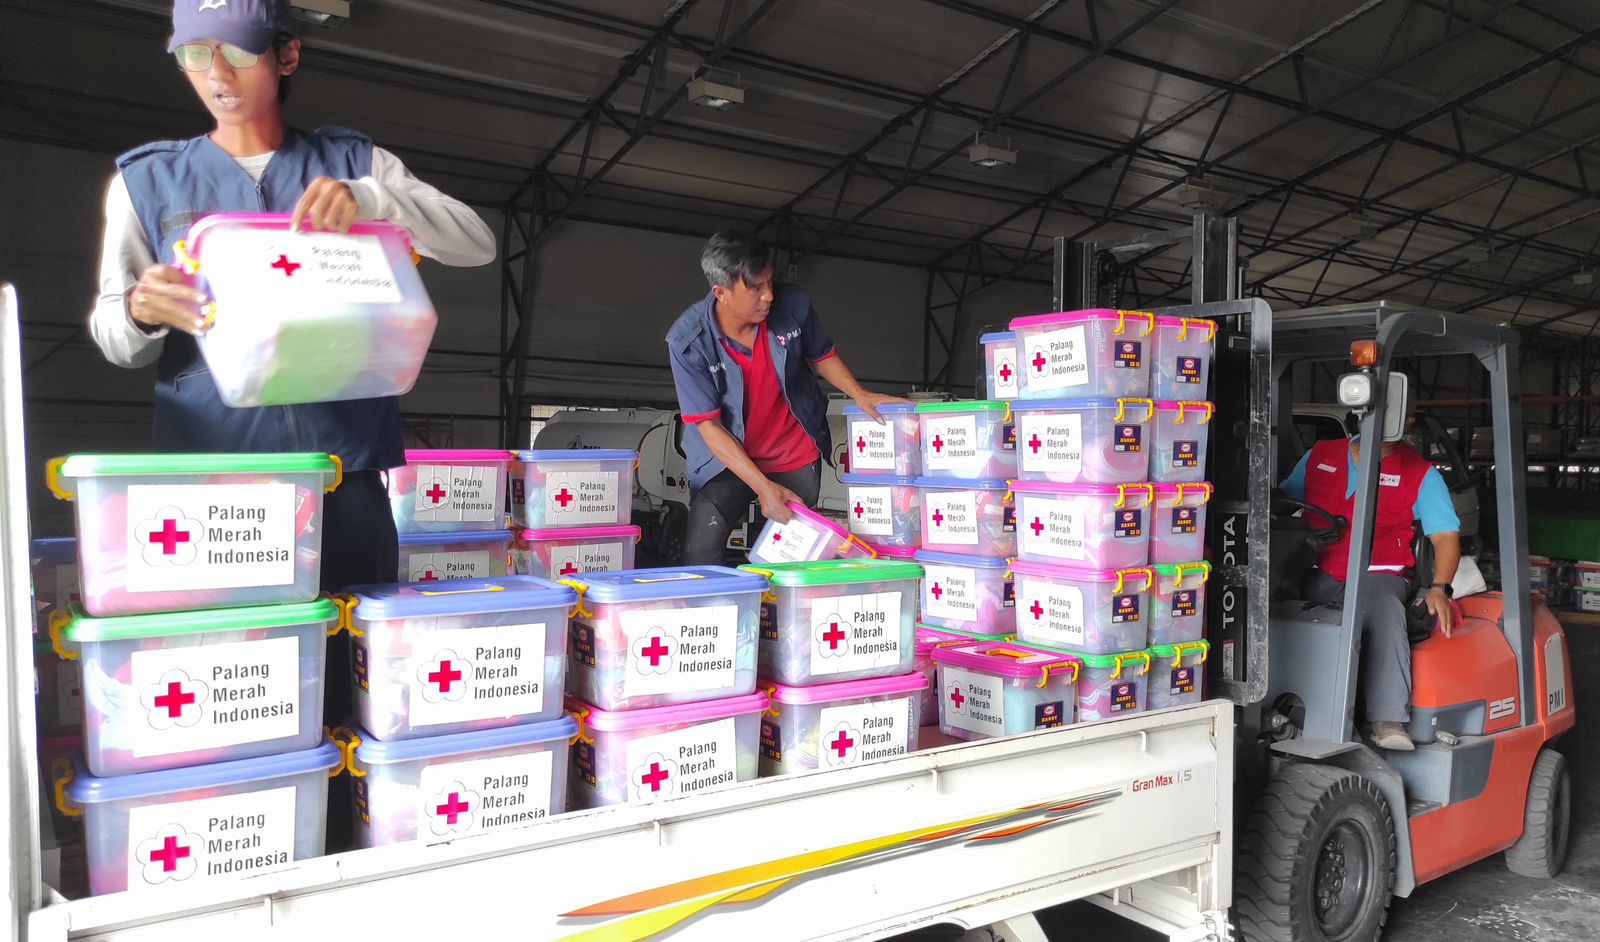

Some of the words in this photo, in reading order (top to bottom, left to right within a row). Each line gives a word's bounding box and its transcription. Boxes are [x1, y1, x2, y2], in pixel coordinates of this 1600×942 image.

[1050, 341, 1073, 351] Palang
[1052, 353, 1072, 363] Merah
[1052, 364, 1085, 376] Indonesia
[869, 430, 885, 439] Palang
[948, 428, 966, 436] Palang
[1047, 427, 1069, 436] Palang
[948, 438, 965, 446] Merah
[1047, 439, 1068, 448] Merah
[1047, 451, 1080, 460] Indonesia
[454, 478, 482, 488] Palang
[580, 482, 606, 491] Palang
[454, 489, 480, 498] Merah
[580, 492, 604, 501] Merah
[453, 500, 492, 510] Indonesia
[579, 503, 615, 512] Indonesia
[948, 503, 966, 511] Palang
[208, 505, 266, 522] Palang
[1050, 511, 1072, 523] Palang
[208, 527, 262, 542] Merah
[1050, 524, 1070, 534] Merah
[1050, 536, 1082, 547] Indonesia
[208, 547, 289, 564] Indonesia
[447, 563, 474, 571] Palang
[1223, 516, 1235, 629] TOOTA
[946, 576, 965, 588] Palang
[1049, 596, 1071, 609] Palang
[854, 611, 885, 623] Palang
[1049, 608, 1070, 619] Merah
[680, 625, 718, 638] Palang
[854, 626, 883, 638] Merah
[1049, 621, 1081, 634] Indonesia
[476, 646, 521, 660] Palang
[680, 642, 715, 655] Merah
[854, 640, 897, 655] Indonesia
[212, 664, 269, 680] Palang
[476, 664, 518, 680] Merah
[679, 658, 732, 673] Indonesia
[213, 684, 266, 703] Merah
[474, 682, 539, 699] Indonesia
[969, 684, 991, 699] Palang
[970, 697, 990, 710] Merah
[1550, 688, 1563, 709] PMI
[213, 702, 293, 725] Indonesia
[1490, 697, 1515, 720] 25
[863, 716, 893, 729] Palang
[970, 709, 1002, 725] Indonesia
[863, 731, 891, 745] Merah
[680, 741, 716, 758] Palang
[862, 744, 904, 761] Indonesia
[680, 758, 715, 776] Merah
[484, 775, 528, 790] Palang
[680, 770, 733, 793] Indonesia
[1132, 779, 1153, 792] Gran
[1156, 775, 1173, 788] Max
[483, 792, 524, 809] Merah
[208, 814, 265, 832] Palang
[482, 808, 545, 828] Indonesia
[208, 834, 261, 854] Merah
[208, 851, 288, 875] Indonesia
